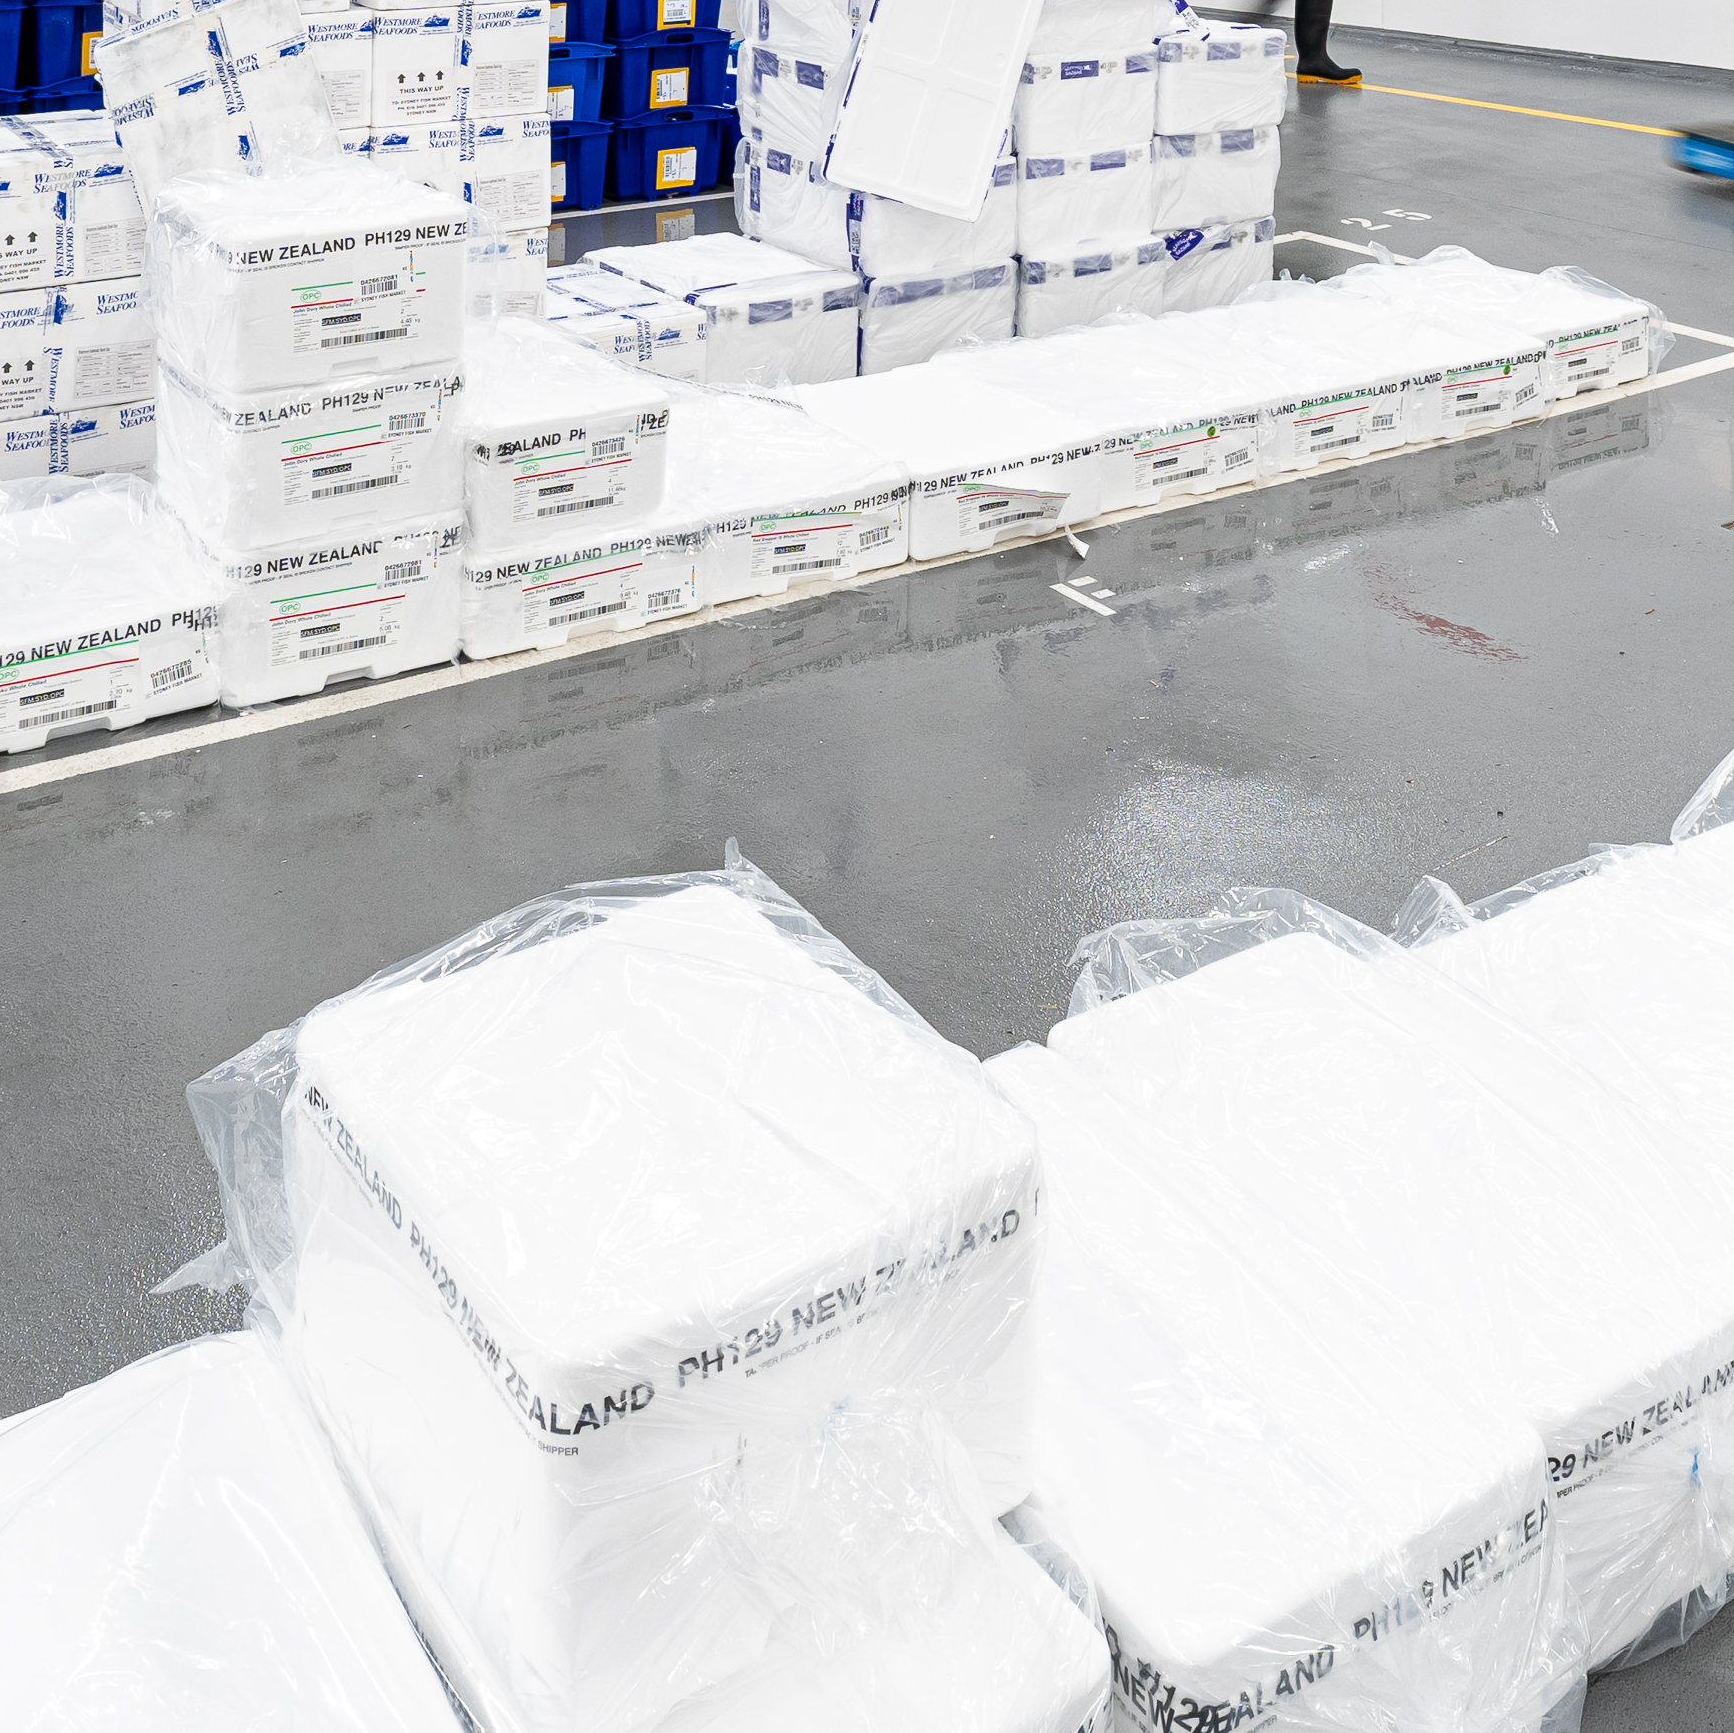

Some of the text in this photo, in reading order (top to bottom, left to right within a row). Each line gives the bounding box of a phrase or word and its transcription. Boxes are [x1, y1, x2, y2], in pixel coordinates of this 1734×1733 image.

[308, 22, 358, 34] WESTMORE
[374, 16, 422, 27] WESTMORE
[307, 32, 353, 42] SEAFOODS
[372, 26, 417, 36] SEAFOODS
[34, 168, 91, 183] WESTMORE
[33, 179, 87, 194] SEAFOODS
[54, 221, 64, 278] WESTMORE
[66, 226, 74, 277] SEAFOODS
[237, 224, 450, 265] NEW ZEALAND PH129 NEW
[6, 250, 24, 258] WAY
[24, 259, 46, 267] MARKET
[302, 291, 321, 301] OPC
[2, 378, 20, 386] WAY
[235, 390, 369, 426] ZEALAND PH129
[267, 540, 383, 574] NEW ZEALAND
[497, 561, 530, 579] NEW
[535, 547, 602, 570] ZEALAND
[31, 639, 72, 660] NEW
[78, 619, 161, 651] ZEALAND
[337, 1117, 402, 1229] ZEALAND
[505, 1356, 655, 1436] ZEALAND
[678, 1318, 783, 1388] PH129
[792, 1276, 867, 1336] NEW
[538, 1439, 579, 1456] SHIPPER
[1583, 1416, 1635, 1468] NEW
